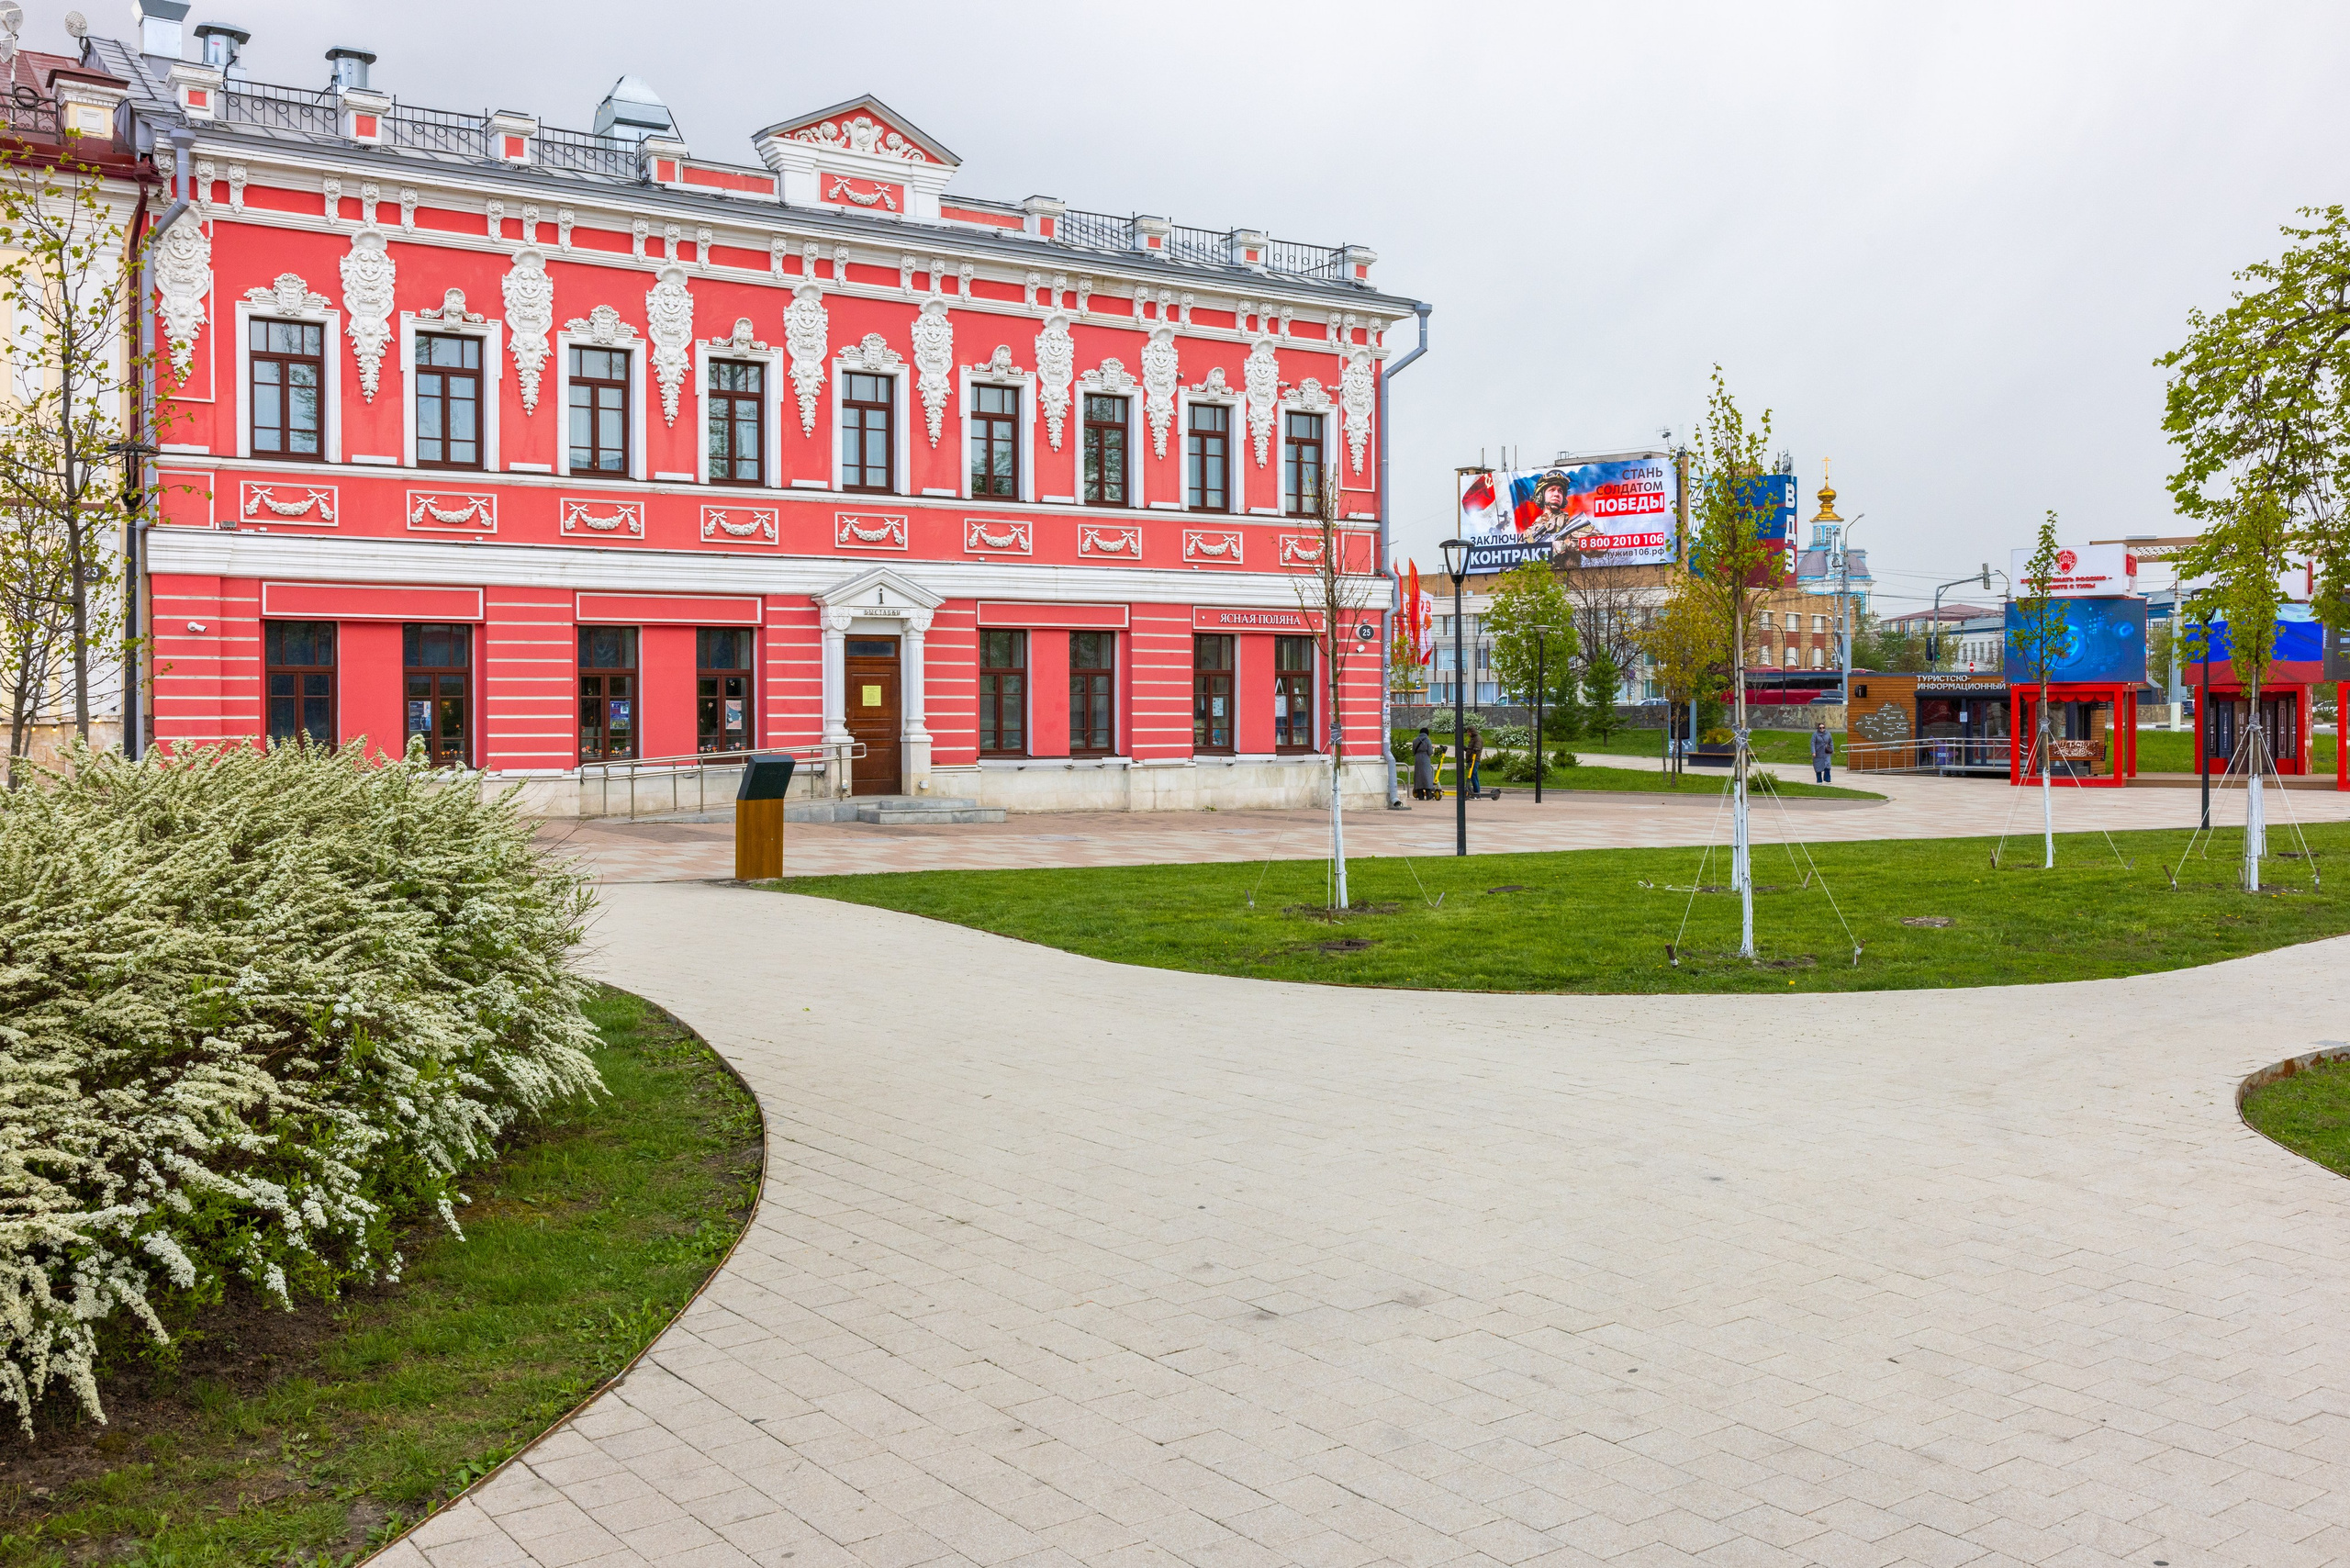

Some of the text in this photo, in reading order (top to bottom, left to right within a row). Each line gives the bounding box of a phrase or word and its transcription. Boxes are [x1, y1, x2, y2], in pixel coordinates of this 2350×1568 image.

[1621, 467, 1663, 480] СТАНЬ
[1596, 481, 1663, 495] СОЛДАТОМ
[1595, 495, 1663, 513] ПОБЕДЫ
[1785, 482, 1796, 575] ВДВ
[1470, 533, 1525, 545] ЗАКЛЮЧИ
[1580, 534, 1663, 548] 8 800 2010 106
[1470, 547, 1551, 565] КОНТРАКТ
[84, 566, 99, 577] 23
[1220, 613, 1301, 625] ЯСНАЯ ПОЛЯНА
[1362, 628, 1371, 636] 25
[1917, 681, 2006, 690] ИНФОРМАЦИОННЫЙ
